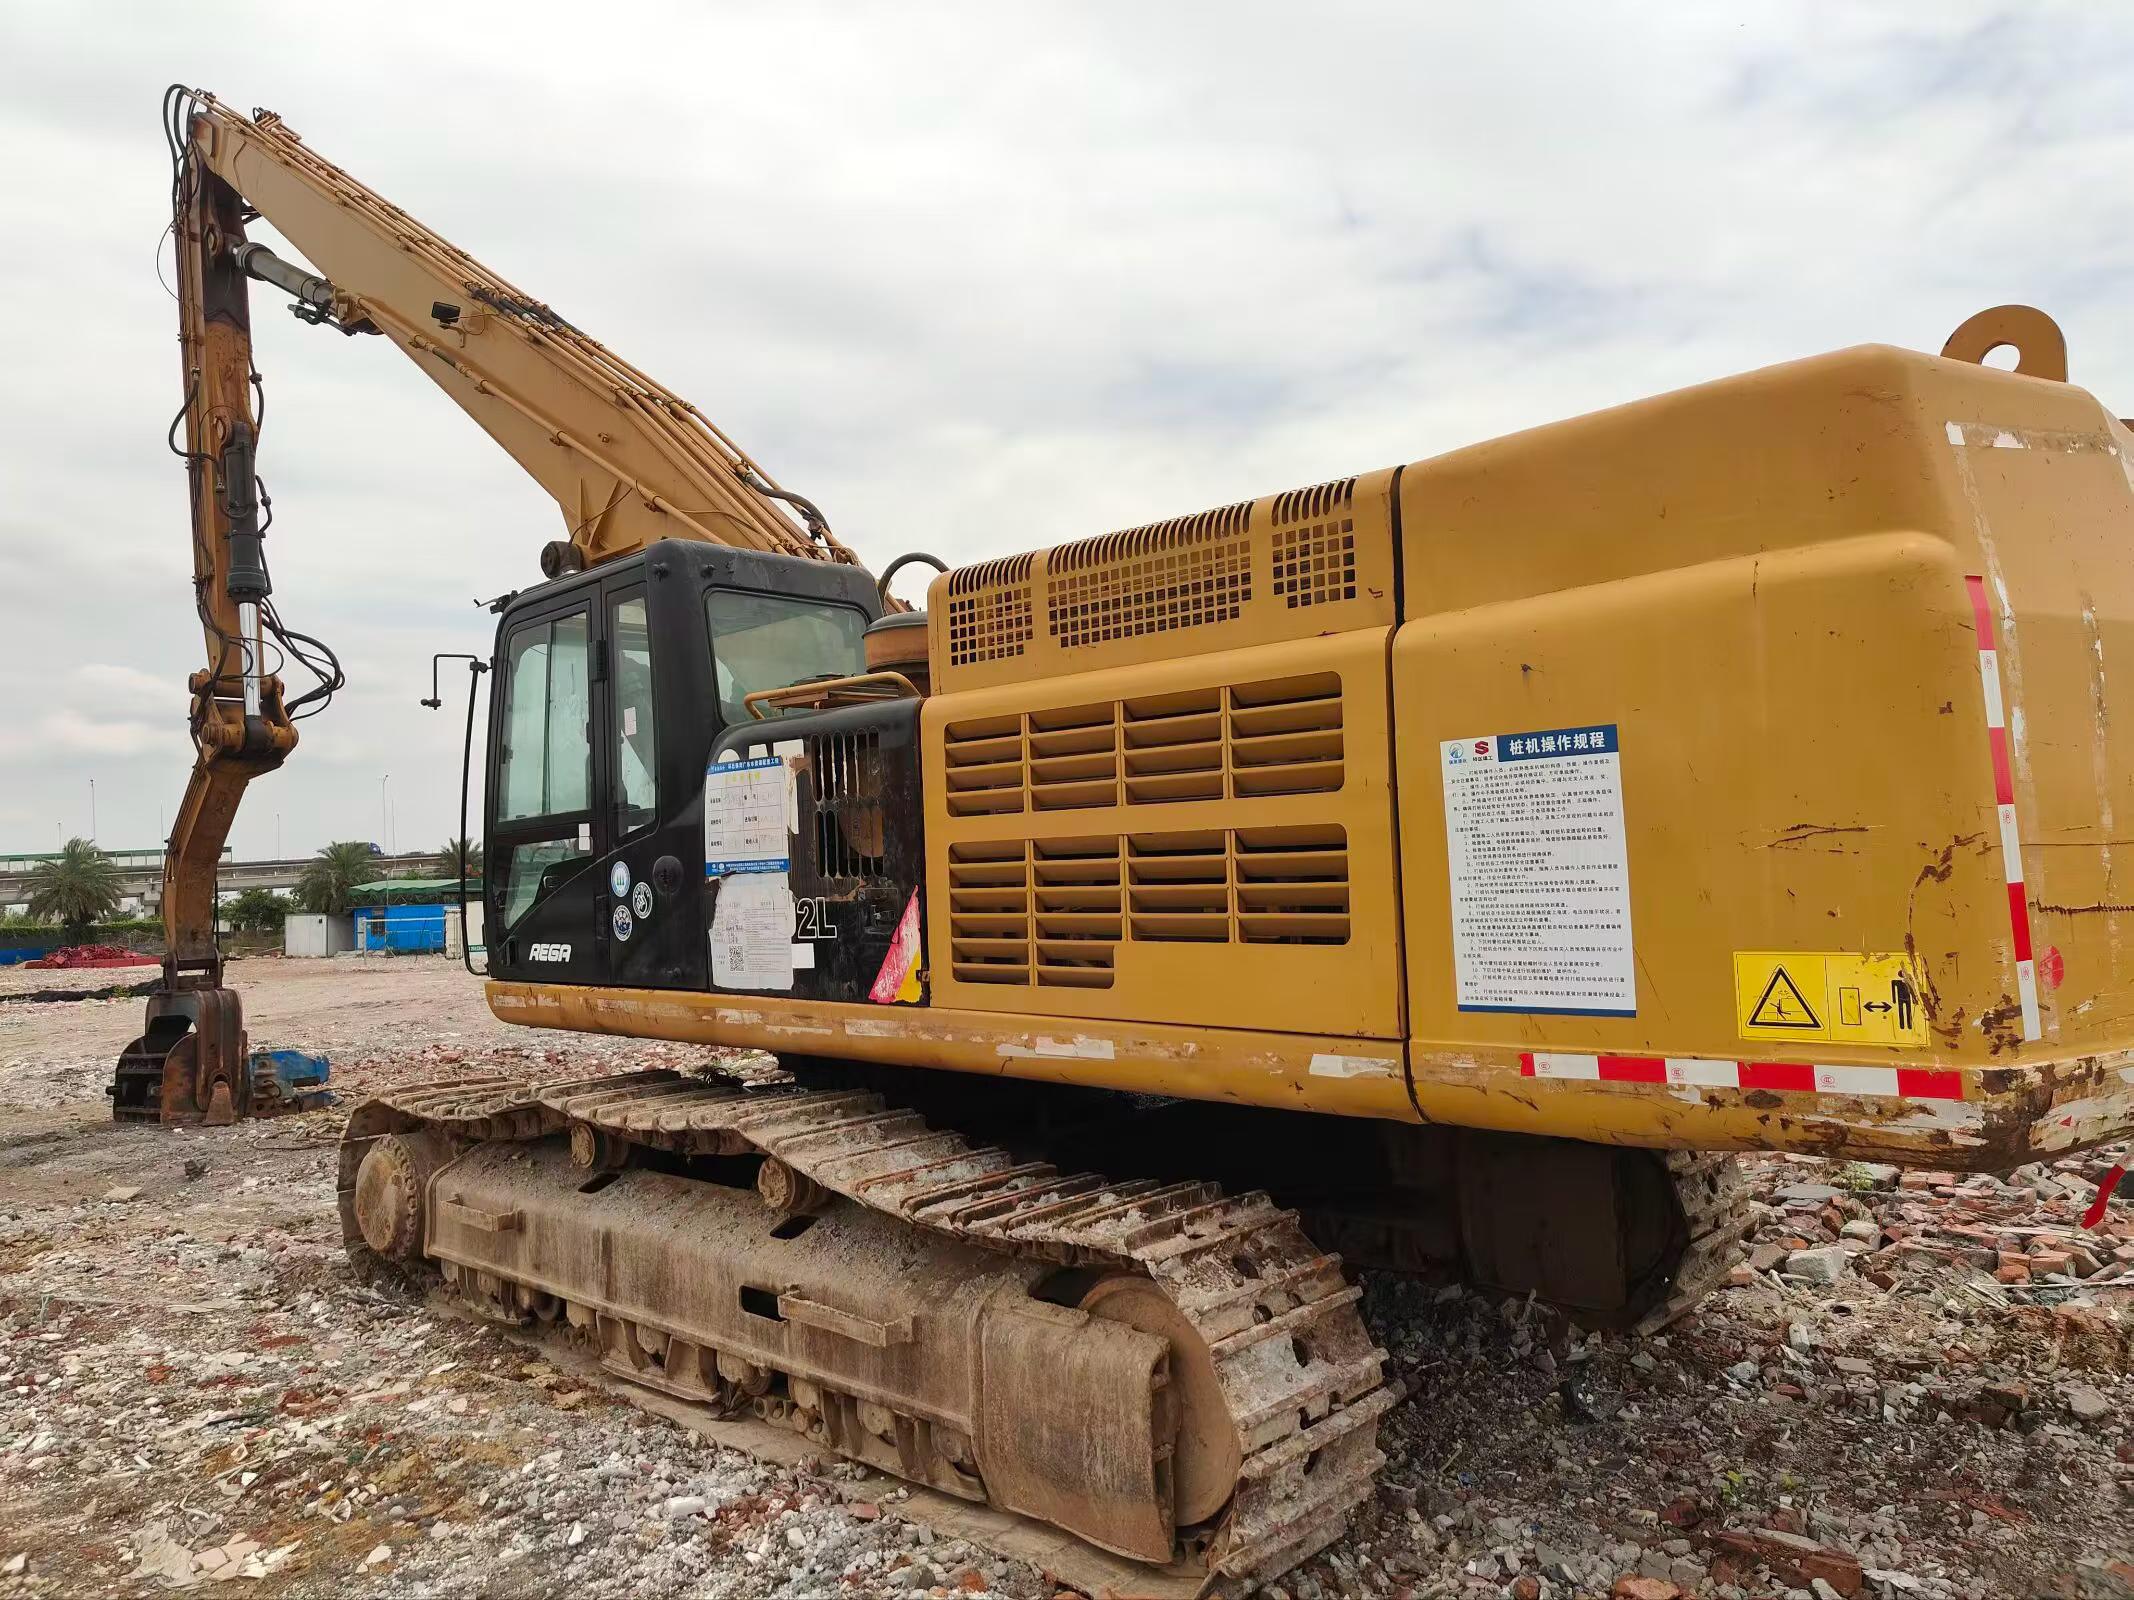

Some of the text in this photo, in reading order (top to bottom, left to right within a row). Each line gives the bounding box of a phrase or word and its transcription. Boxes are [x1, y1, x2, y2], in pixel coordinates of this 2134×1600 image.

[1509, 731, 1605, 756] 桩机操作规程
[797, 896, 838, 940] 2L
[529, 943, 572, 962] REGA
